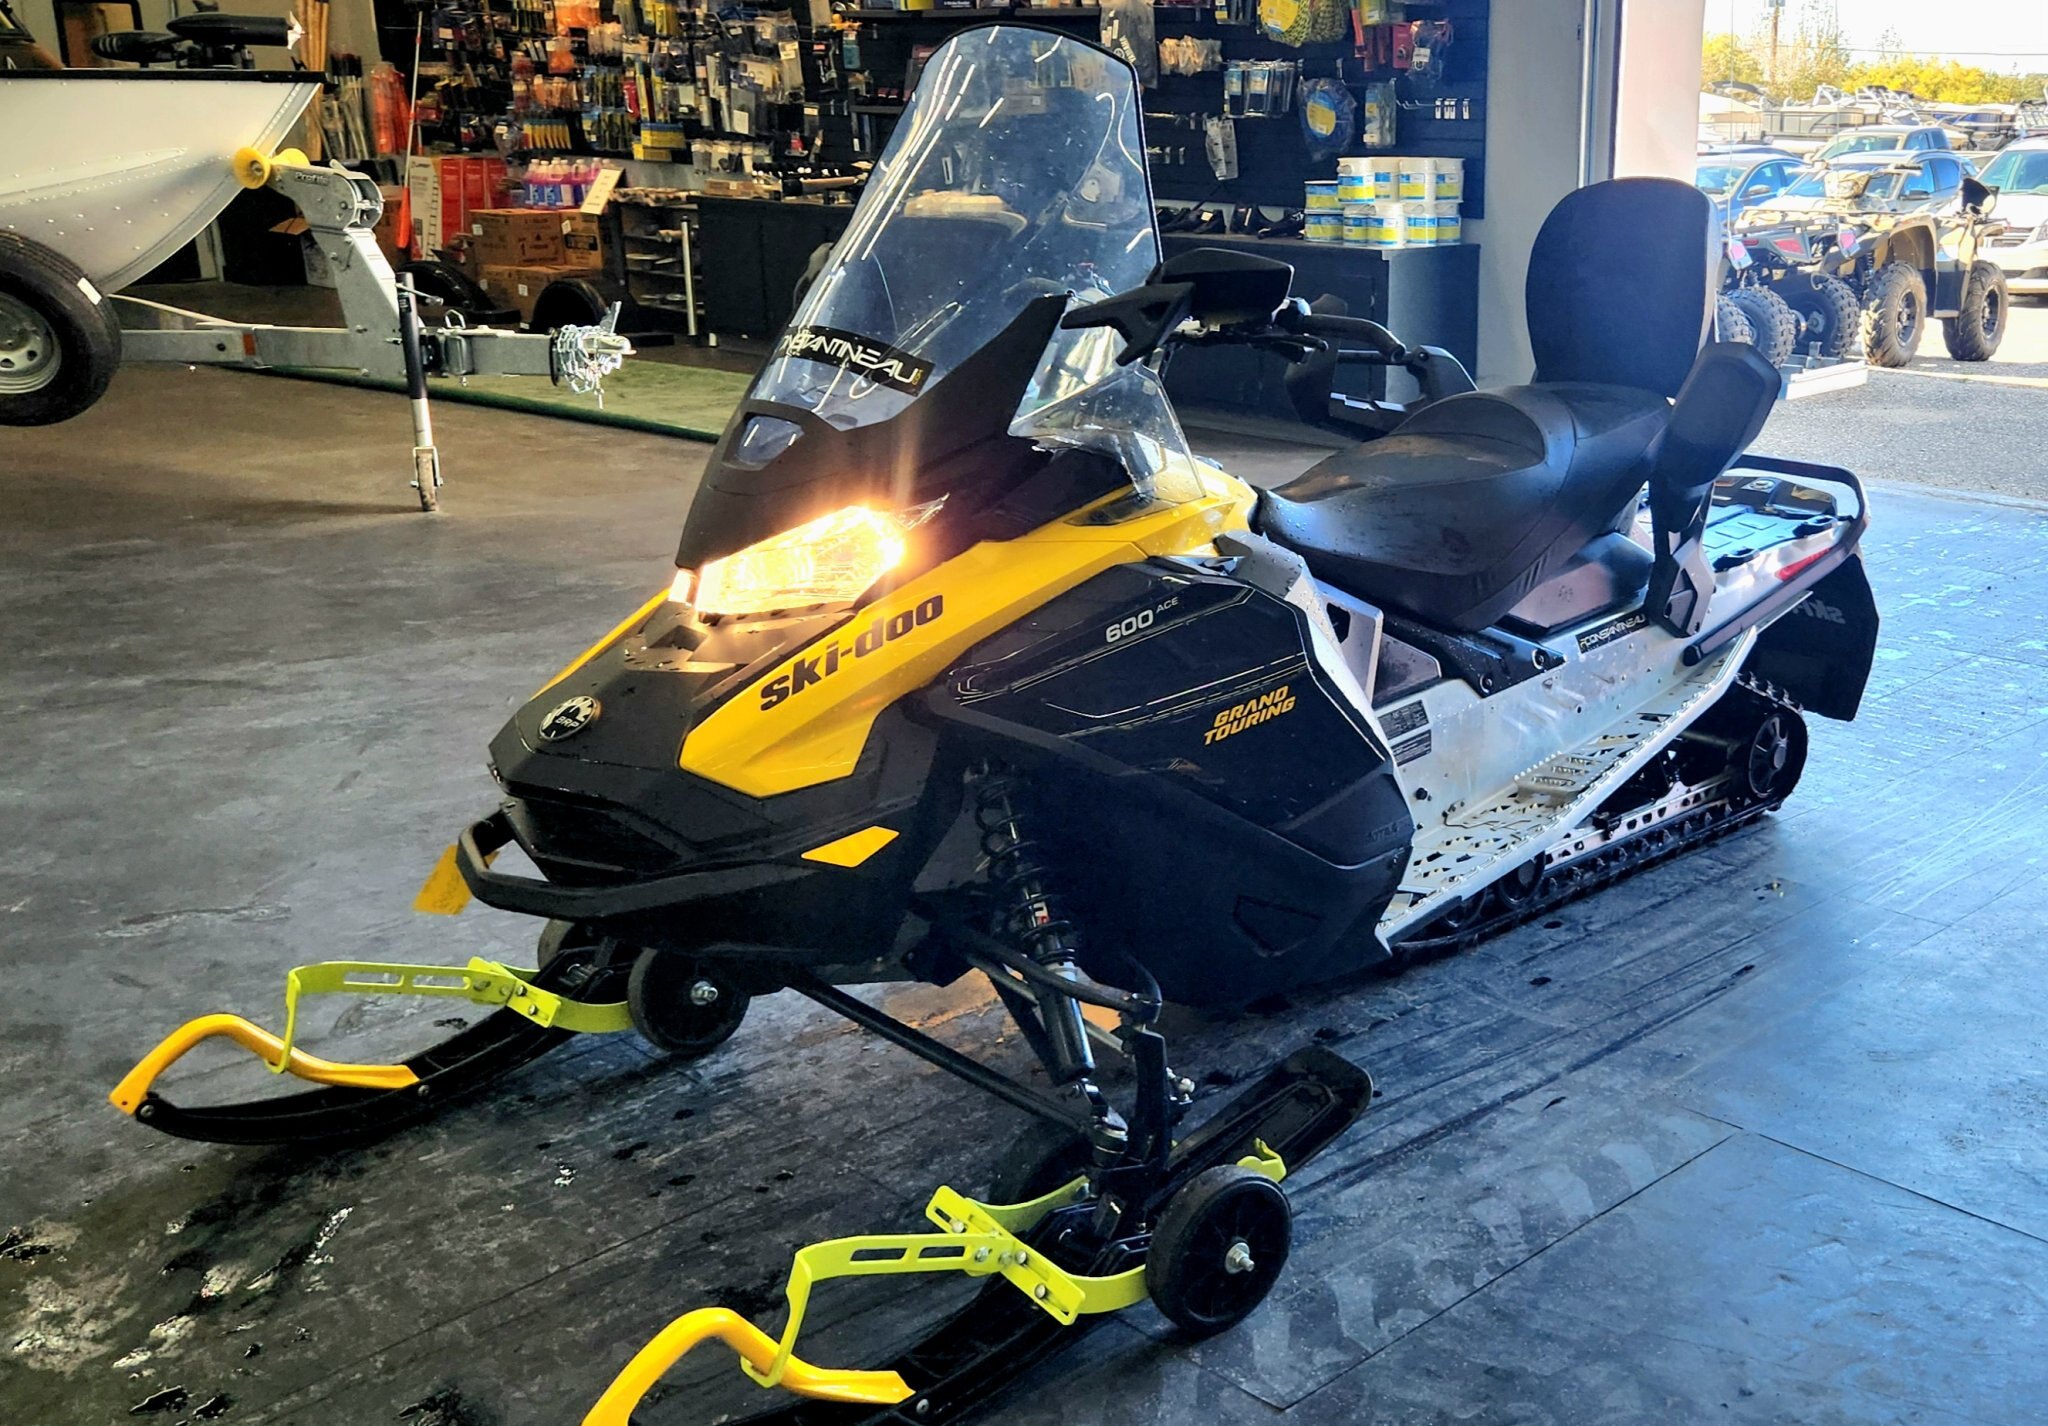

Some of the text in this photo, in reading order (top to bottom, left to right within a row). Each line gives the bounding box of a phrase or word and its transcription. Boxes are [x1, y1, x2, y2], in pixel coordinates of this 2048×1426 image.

[1106, 597, 1179, 642] 600 ACE
[760, 595, 943, 711] ski-doo
[555, 715, 580, 728] BRP
[1204, 695, 1297, 746] TOURING
[1213, 686, 1289, 728] GRAND
